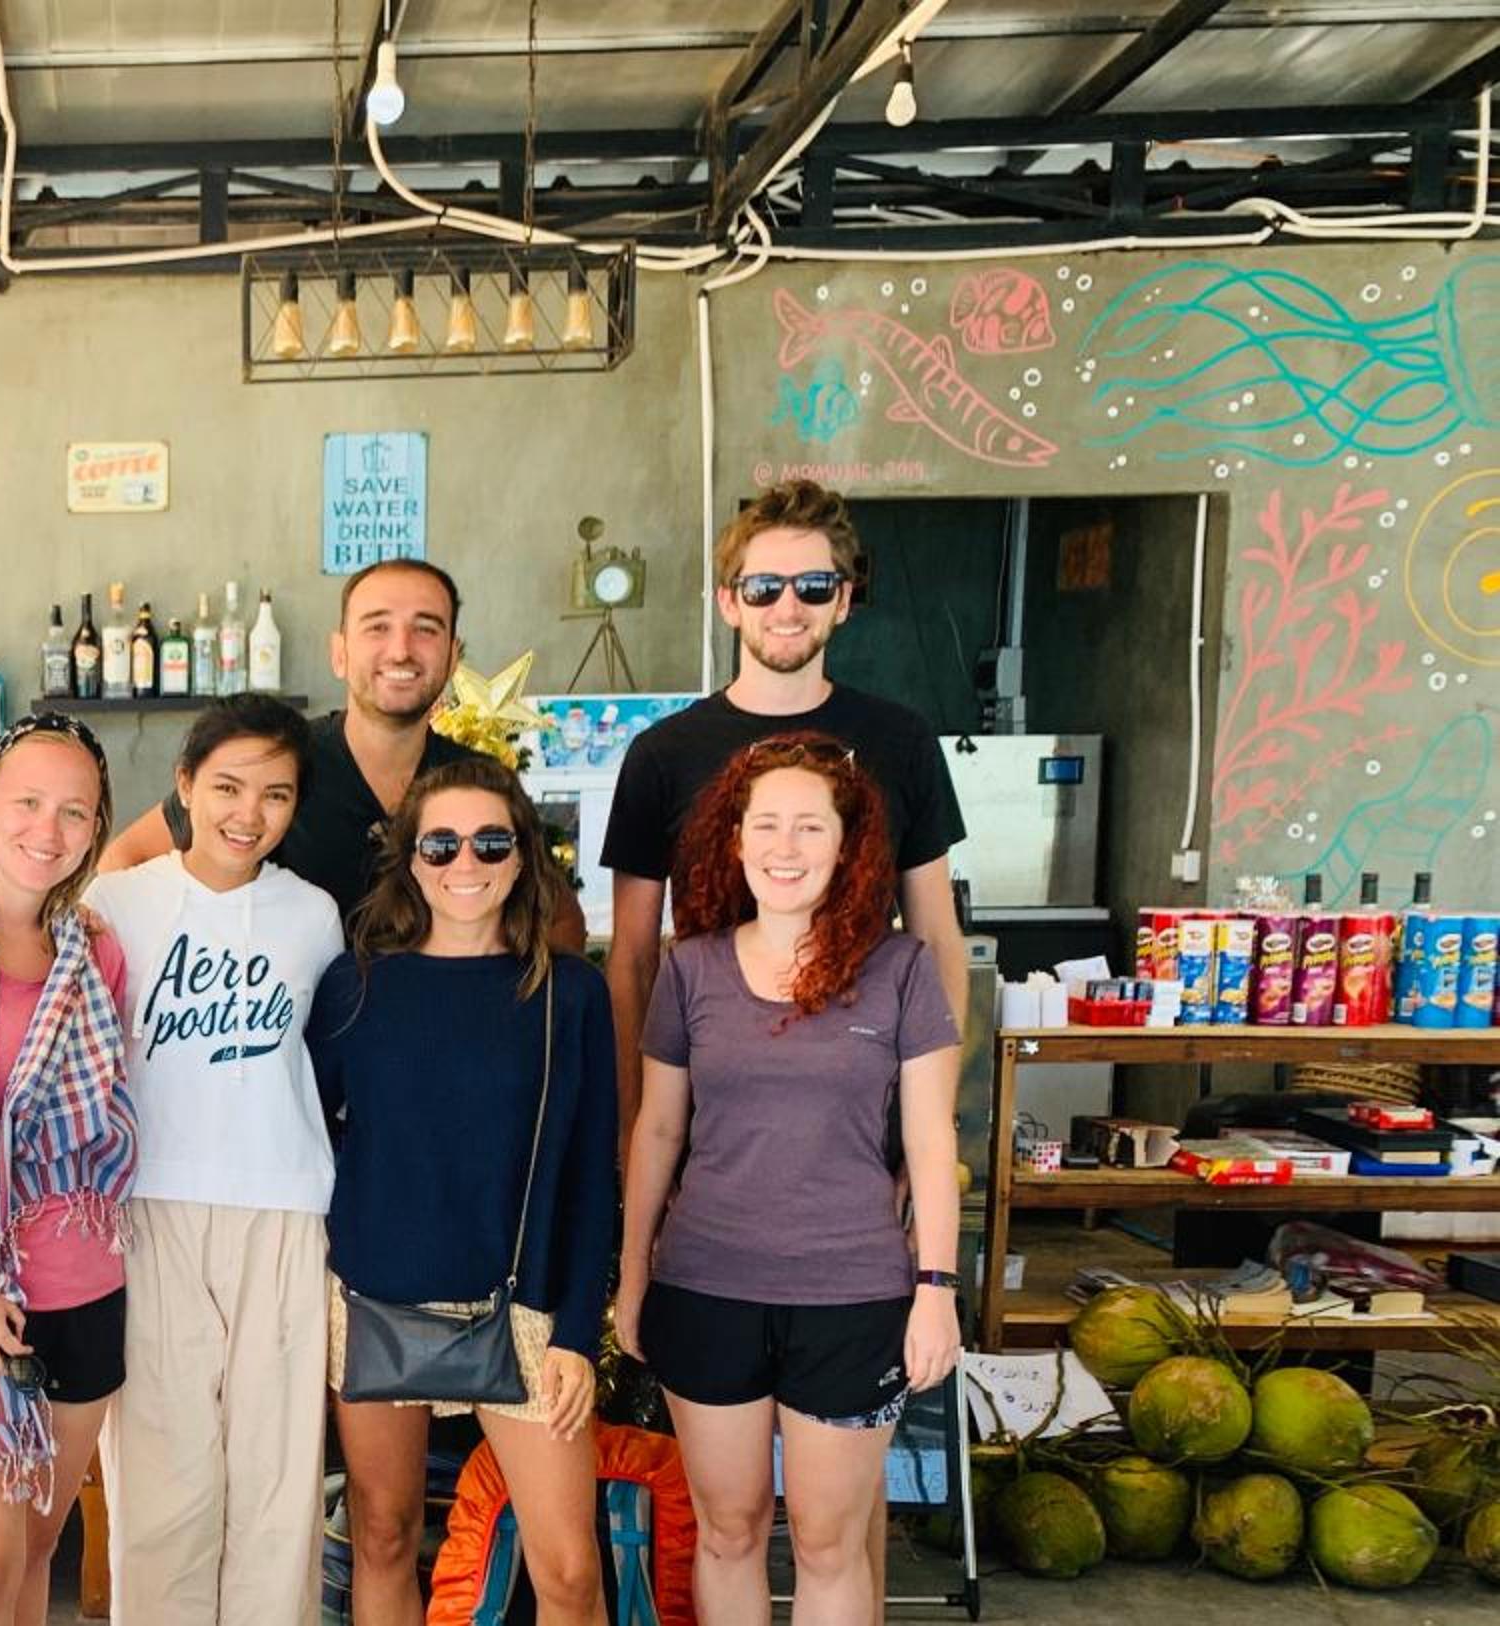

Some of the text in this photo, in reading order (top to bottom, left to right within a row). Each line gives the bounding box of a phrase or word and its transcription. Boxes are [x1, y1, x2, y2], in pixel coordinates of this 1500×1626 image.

[343, 478, 409, 494] SAVE
[332, 499, 418, 517] WATER
[338, 522, 412, 540] DRINK
[334, 543, 414, 564] BEER
[143, 932, 270, 1025] Aéro
